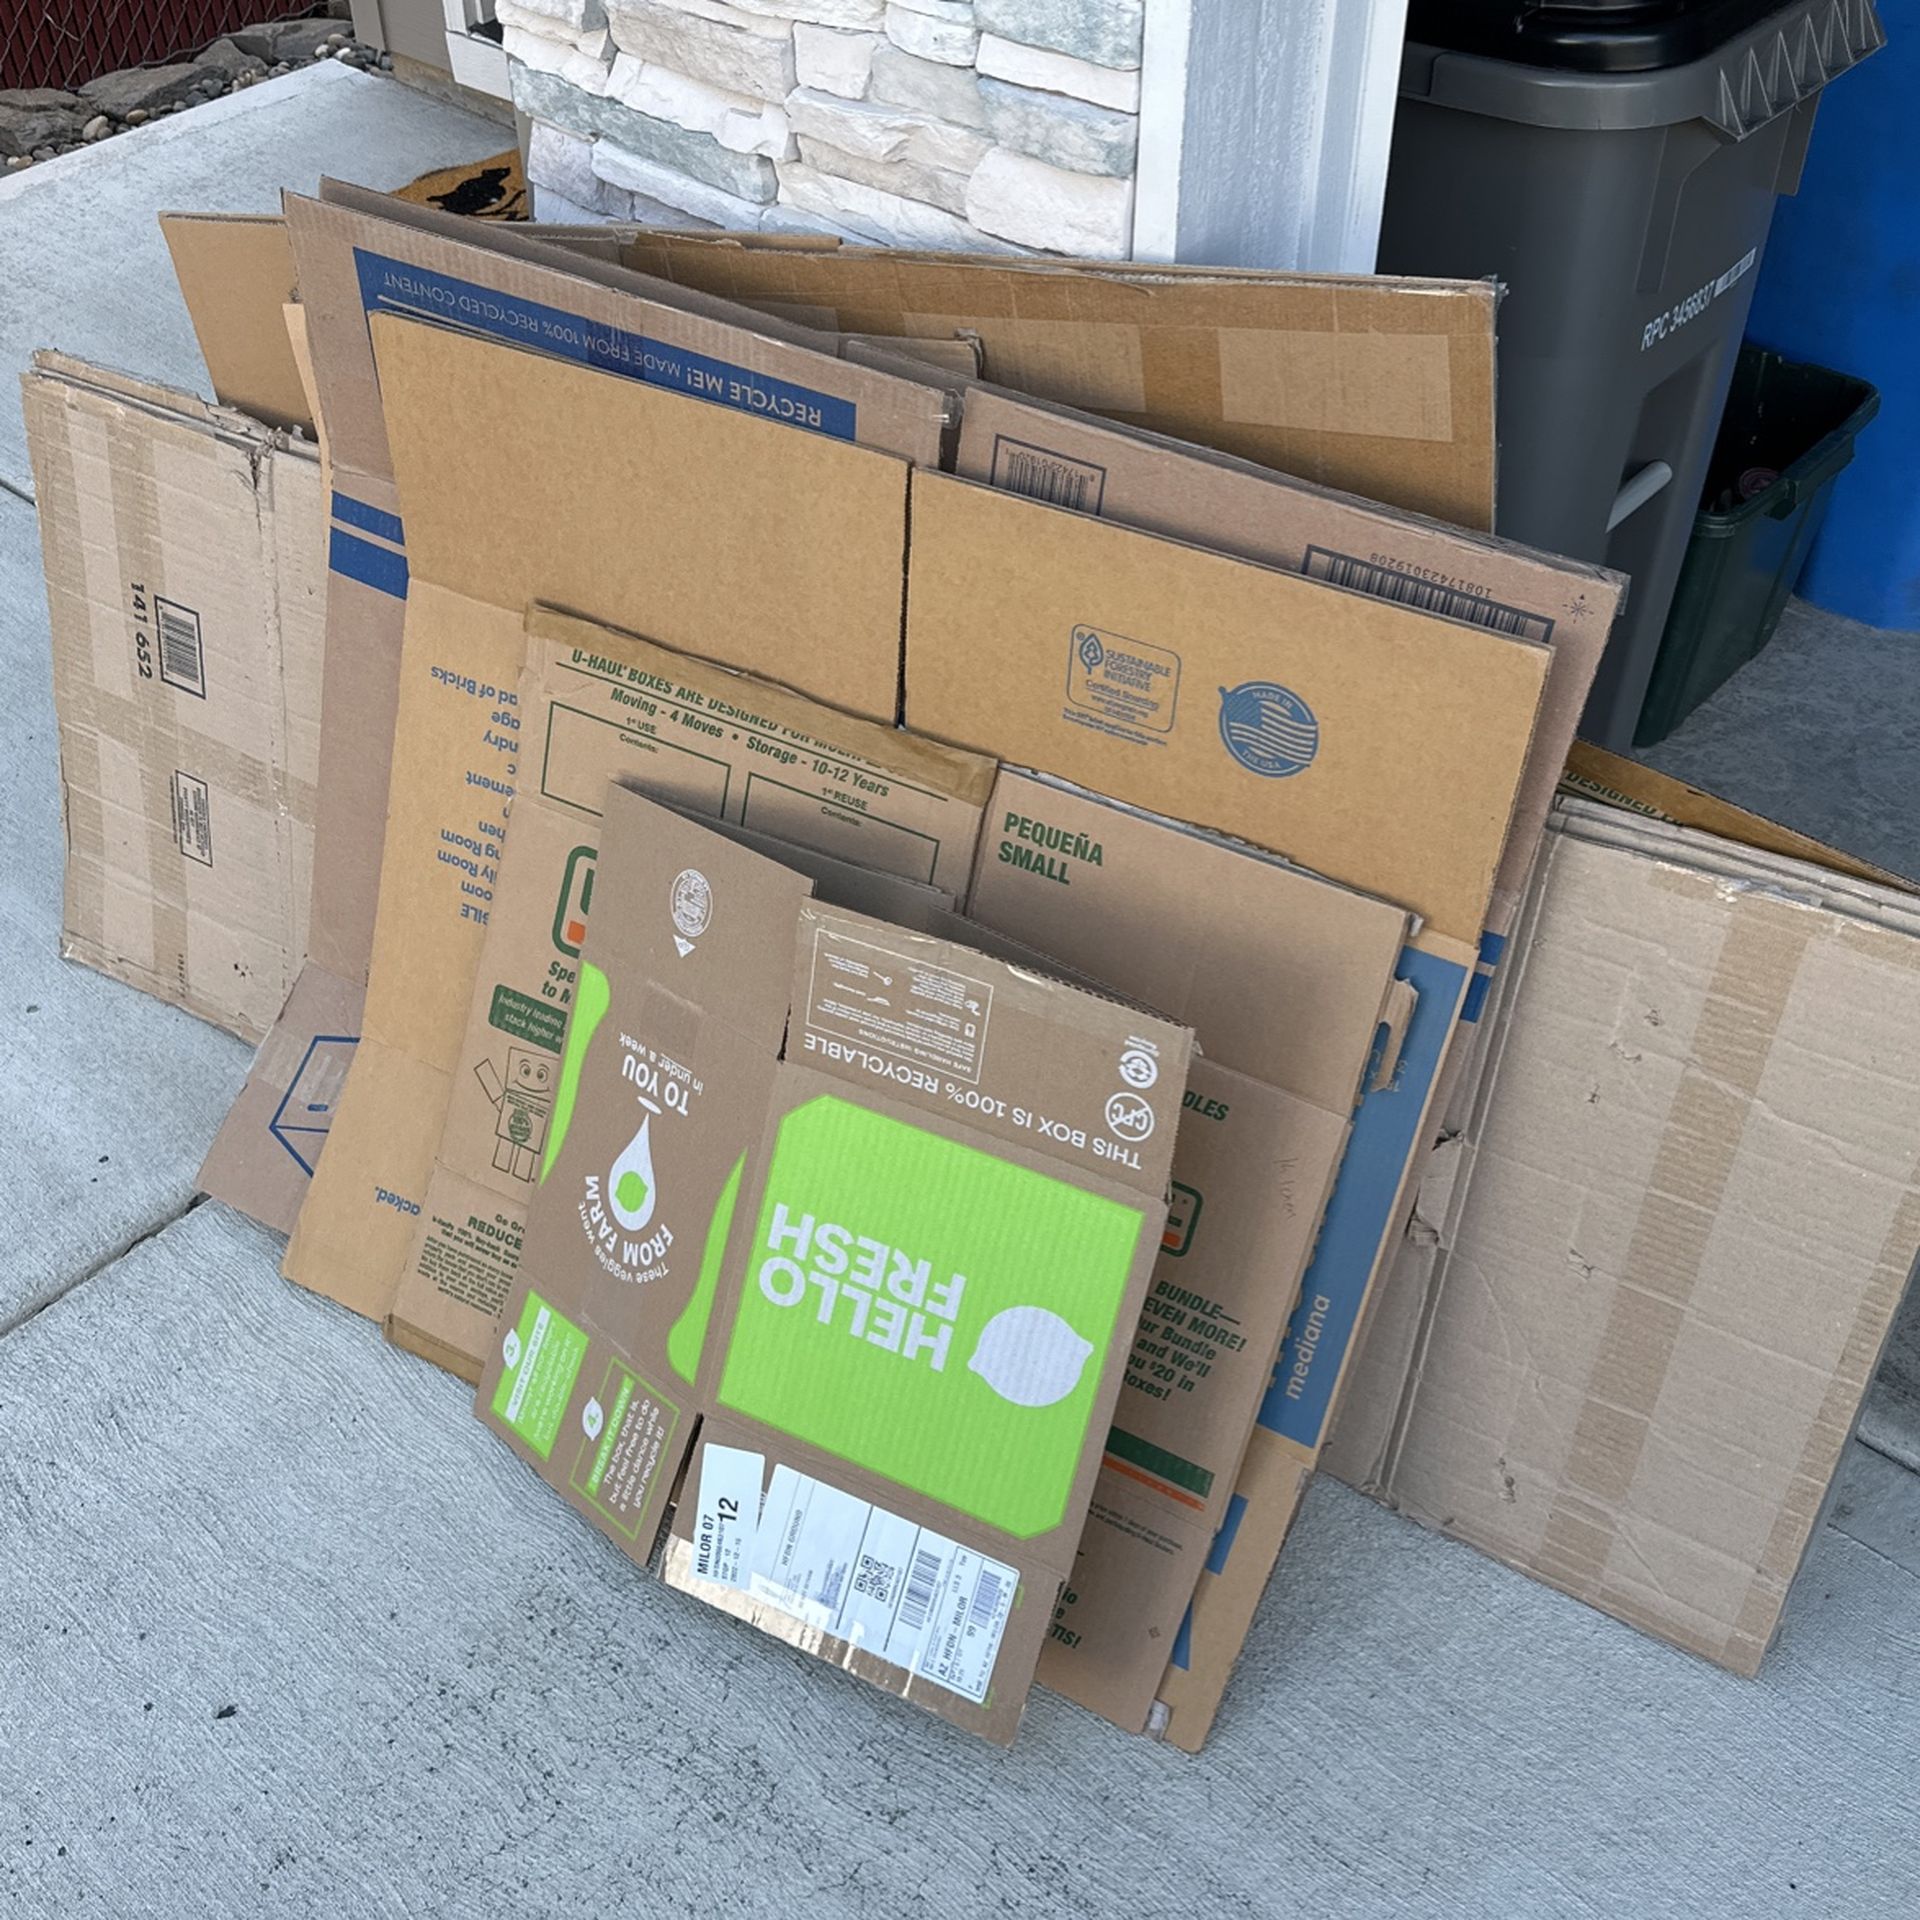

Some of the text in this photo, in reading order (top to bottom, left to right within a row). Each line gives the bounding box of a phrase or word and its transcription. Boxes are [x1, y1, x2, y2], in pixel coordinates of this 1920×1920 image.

[384, 272, 822, 427] RECYCLE ME! MADE FROM 100% RECYCLED CONTENT
[1641, 311, 1670, 352] RPC
[131, 583, 152, 679] 141 652
[431, 666, 518, 706] ad of Bricks
[627, 668, 674, 695] BOXES
[491, 711, 521, 731] age
[637, 720, 657, 735] USE
[484, 730, 519, 753] ndry
[610, 688, 657, 716] Moving
[670, 710, 678, 722] 4
[681, 713, 724, 739] Moves
[746, 736, 798, 764] Storage
[812, 759, 849, 782] 10-12
[852, 770, 889, 797] Years
[466, 770, 515, 798] ement
[833, 791, 869, 811] REUSE
[441, 828, 482, 856] Room
[1003, 811, 1103, 867] PEQUEÑA
[437, 849, 478, 878] Room
[998, 841, 1071, 886] SMALL
[460, 903, 490, 926] ILE
[542, 981, 558, 998] to
[548, 961, 576, 984] Spe
[618, 1032, 647, 1055] week
[622, 1054, 690, 1117] TO YOU
[658, 1060, 692, 1085] under
[693, 1080, 704, 1096] in
[804, 1032, 1143, 1170] THIS BOX IS 100% RECYCLABLE
[1182, 1090, 1230, 1121] DLES
[375, 1186, 422, 1216] acked.
[585, 1175, 618, 1253] FARM
[467, 1215, 523, 1251] REDUCE
[577, 1200, 670, 1284] These veggies went
[622, 1223, 674, 1267] FROM
[767, 1202, 967, 1322] FRESH
[759, 1256, 954, 1373] HELLO
[1143, 1296, 1248, 1352] EVEN MORE!
[1136, 1338, 1169, 1359] and
[1138, 1318, 1217, 1360] ur Bundle
[1285, 1294, 1331, 1401] mediana
[1127, 1354, 1147, 1370] ou
[1177, 1374, 1195, 1392] in
[717, 1496, 739, 1523] 12
[697, 1513, 715, 1575] MILOR 07
